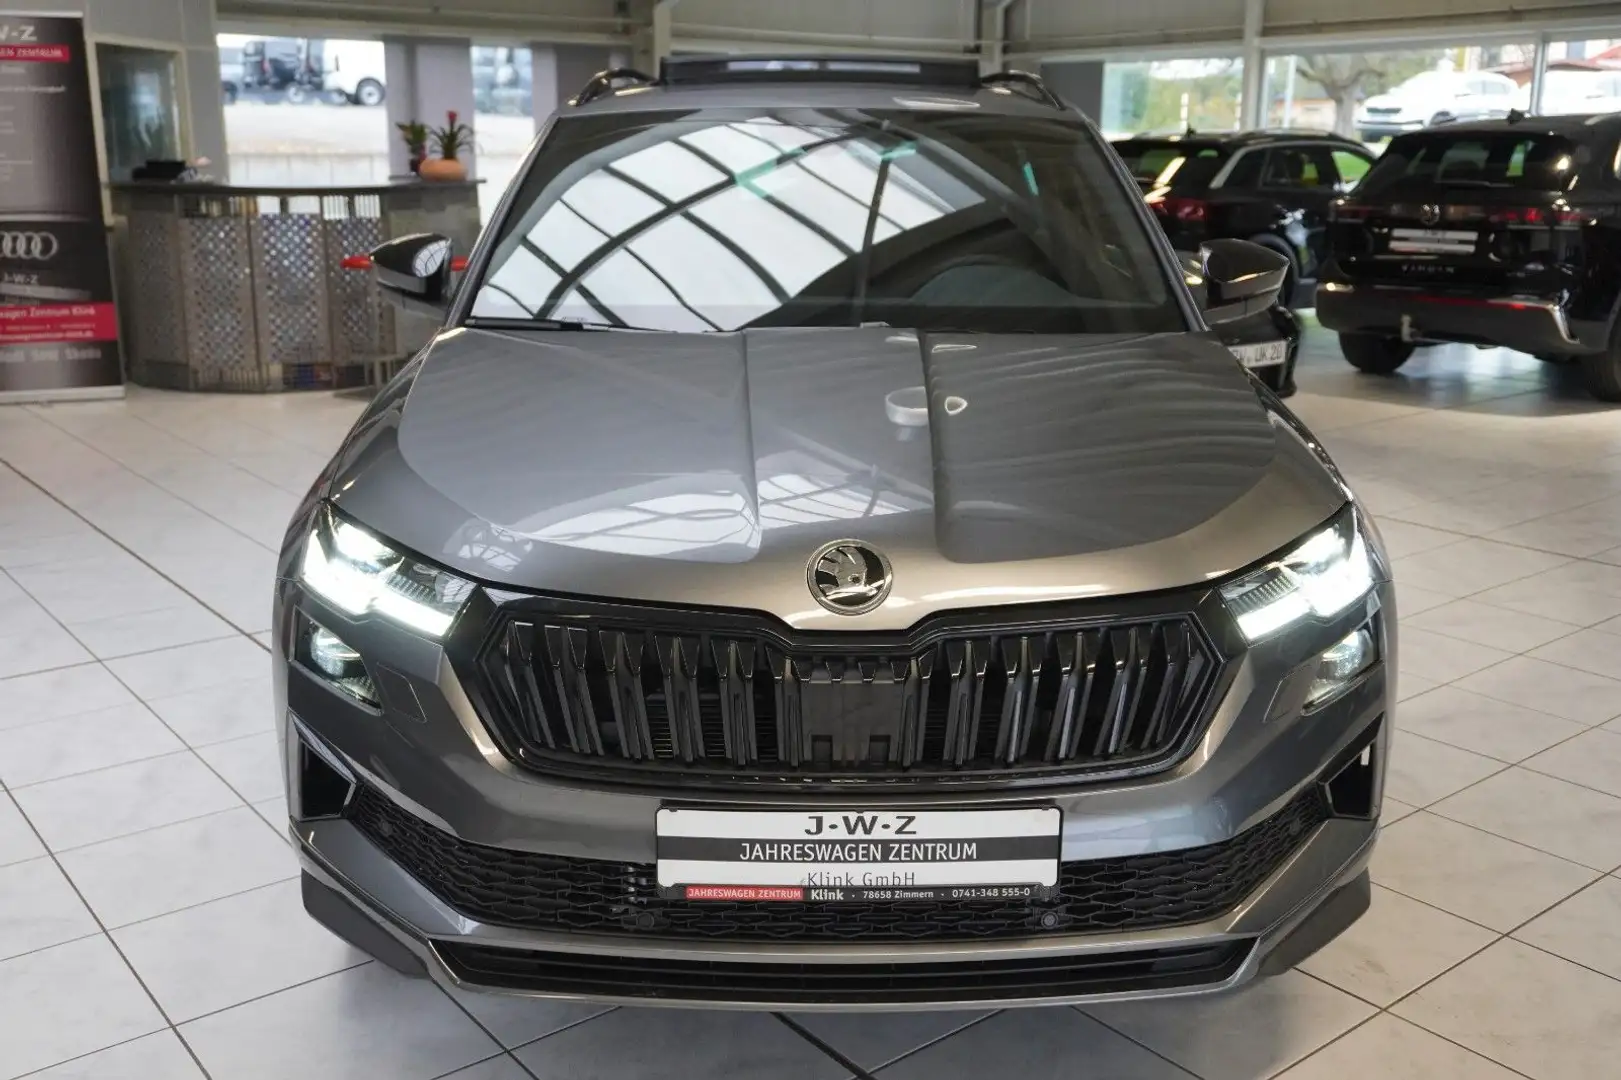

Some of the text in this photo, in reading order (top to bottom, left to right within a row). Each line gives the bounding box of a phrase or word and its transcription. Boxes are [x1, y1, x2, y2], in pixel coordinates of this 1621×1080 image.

[739, 842, 978, 862] JAHRESWAGEN ZENTRUM
[807, 871, 916, 887] Klink GmbH
[687, 887, 1032, 900] JAHRESWAGEN ZENTRUM Klink 78658 Zimmern 0741-348 555-0
